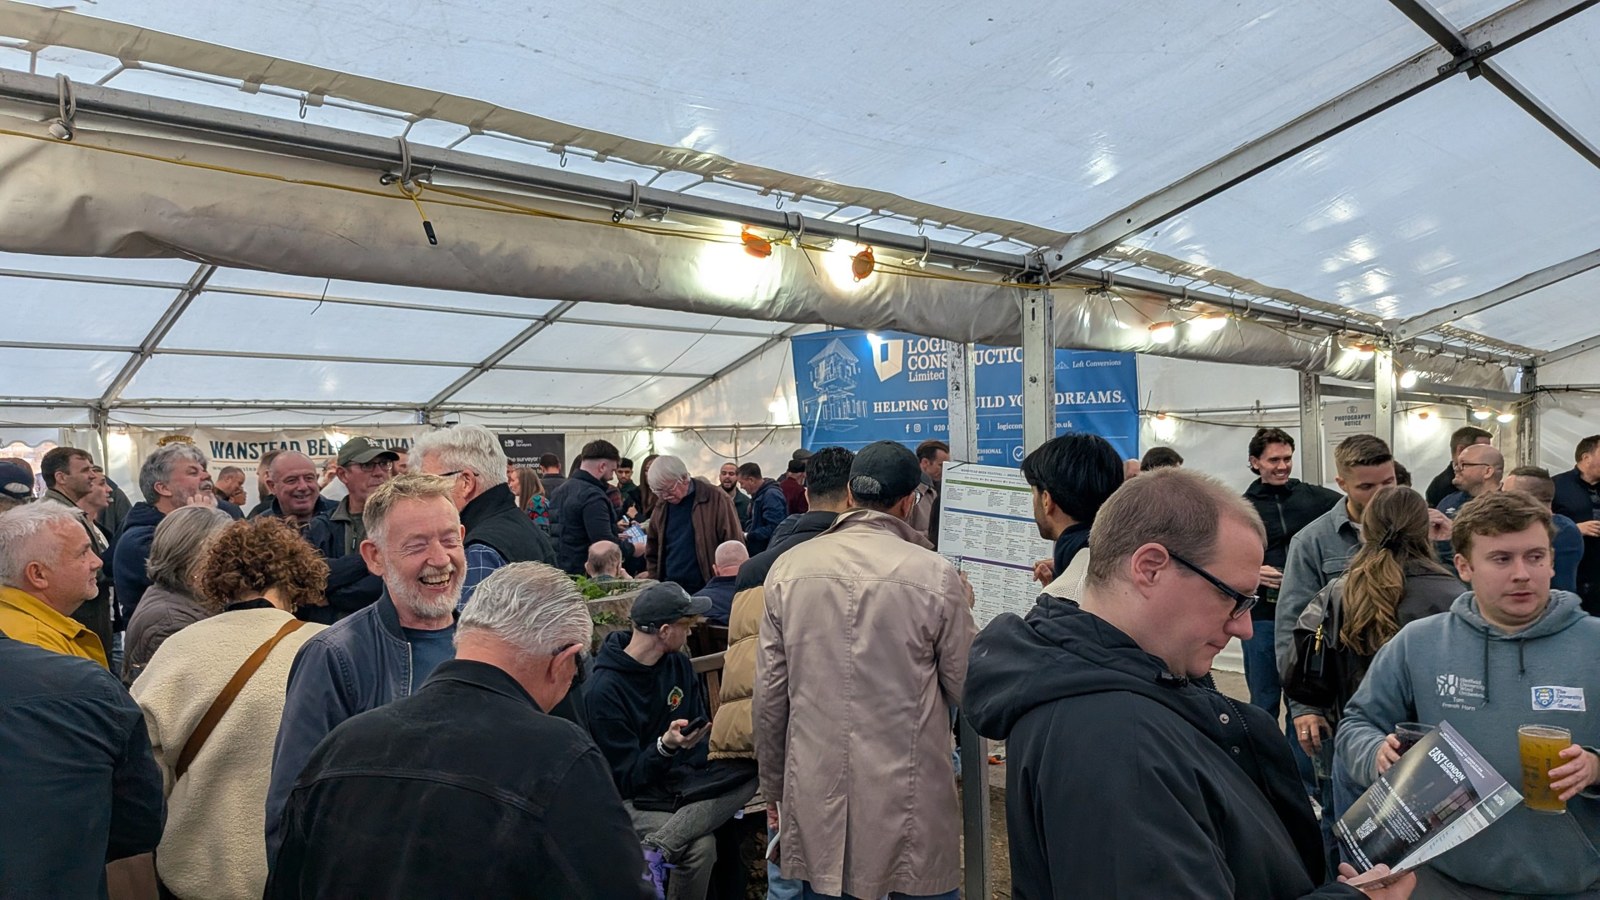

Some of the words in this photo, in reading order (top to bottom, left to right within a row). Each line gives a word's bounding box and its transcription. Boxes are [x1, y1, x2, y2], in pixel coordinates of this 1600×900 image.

[907, 337, 947, 354] LOGI
[1086, 359, 1121, 367] Conversions
[908, 370, 946, 382] Limited
[873, 400, 928, 413] HELPING
[931, 398, 948, 411] YO
[975, 396, 1005, 409] UILD
[1054, 390, 1126, 406] DREAMS.
[1427, 745, 1447, 766] EAST
[1443, 758, 1465, 782] LONDON
